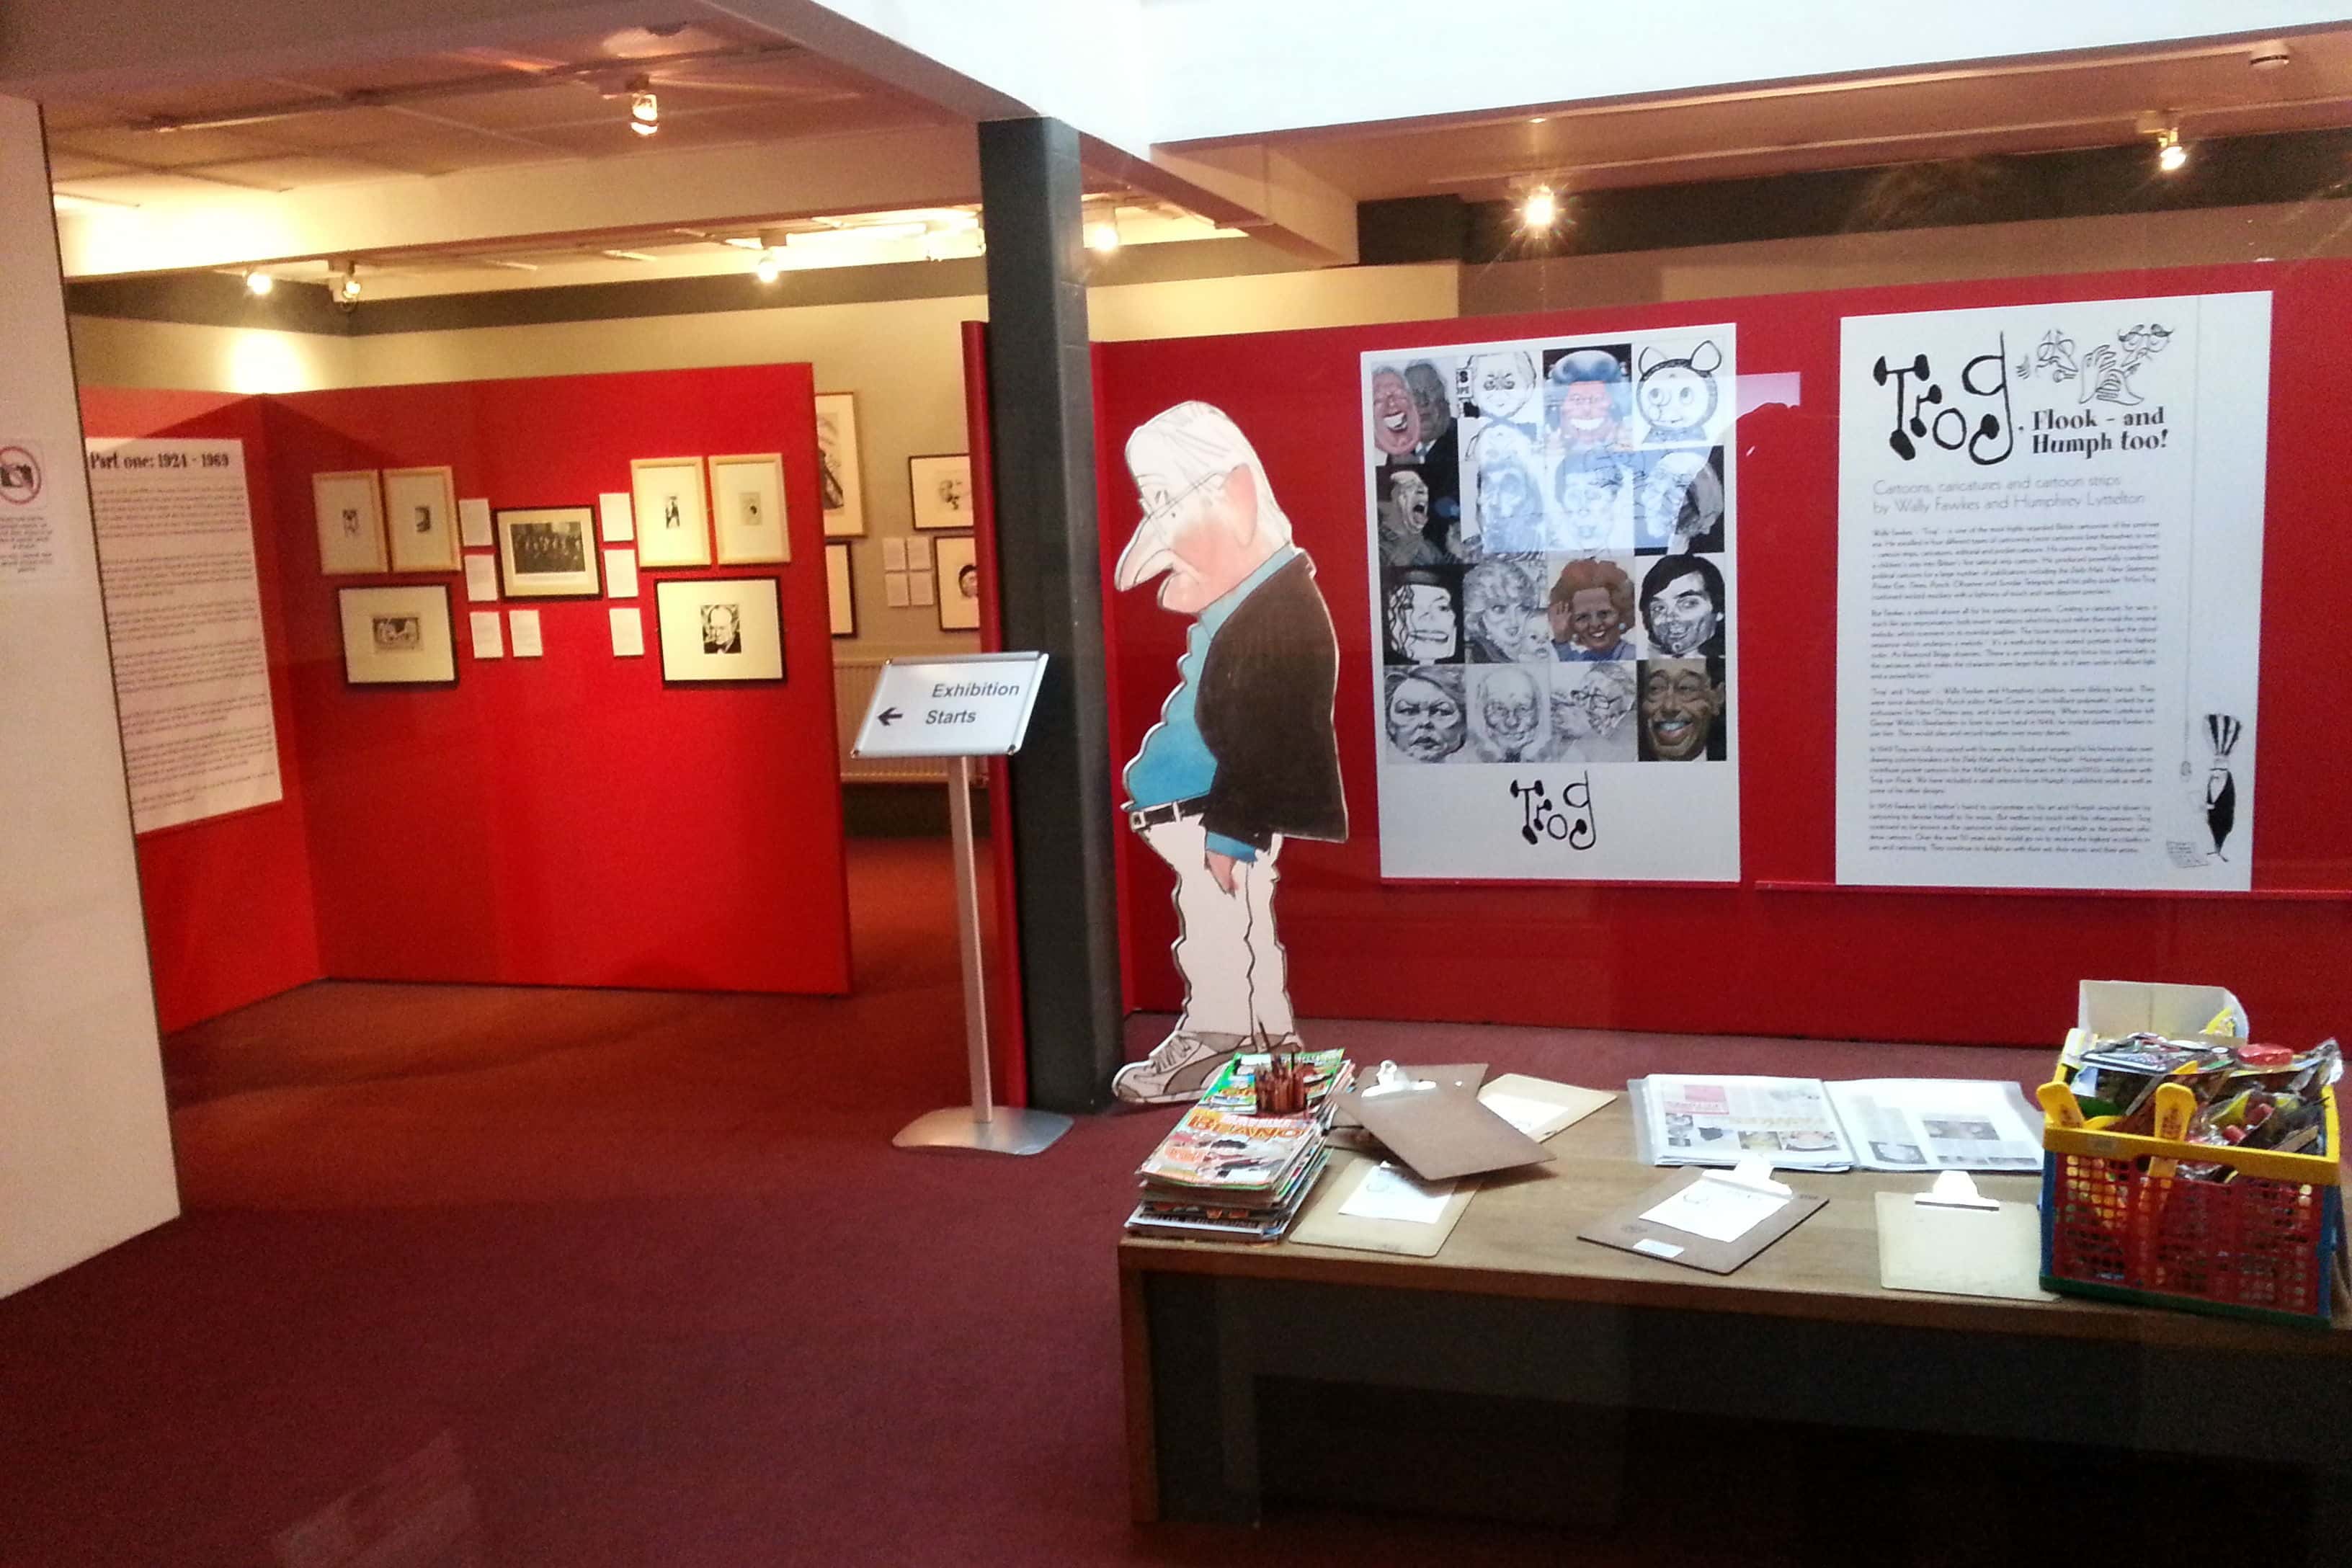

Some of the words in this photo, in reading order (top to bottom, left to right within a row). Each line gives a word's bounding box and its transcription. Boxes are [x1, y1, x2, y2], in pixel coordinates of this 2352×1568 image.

[2031, 409, 2098, 431] Flook
[2124, 406, 2165, 427] and
[2032, 432, 2113, 460] Humph
[2121, 429, 2168, 450] too!
[89, 452, 120, 469] Part
[2005, 475, 2030, 490] and
[2034, 477, 2082, 489] cartoon
[1873, 500, 1891, 514] by
[1984, 495, 2009, 509] and
[932, 682, 1020, 698] Exhibition
[925, 709, 976, 725] Starts
[1510, 770, 1597, 850] Trog
[1188, 1114, 1306, 1141] BEANO
